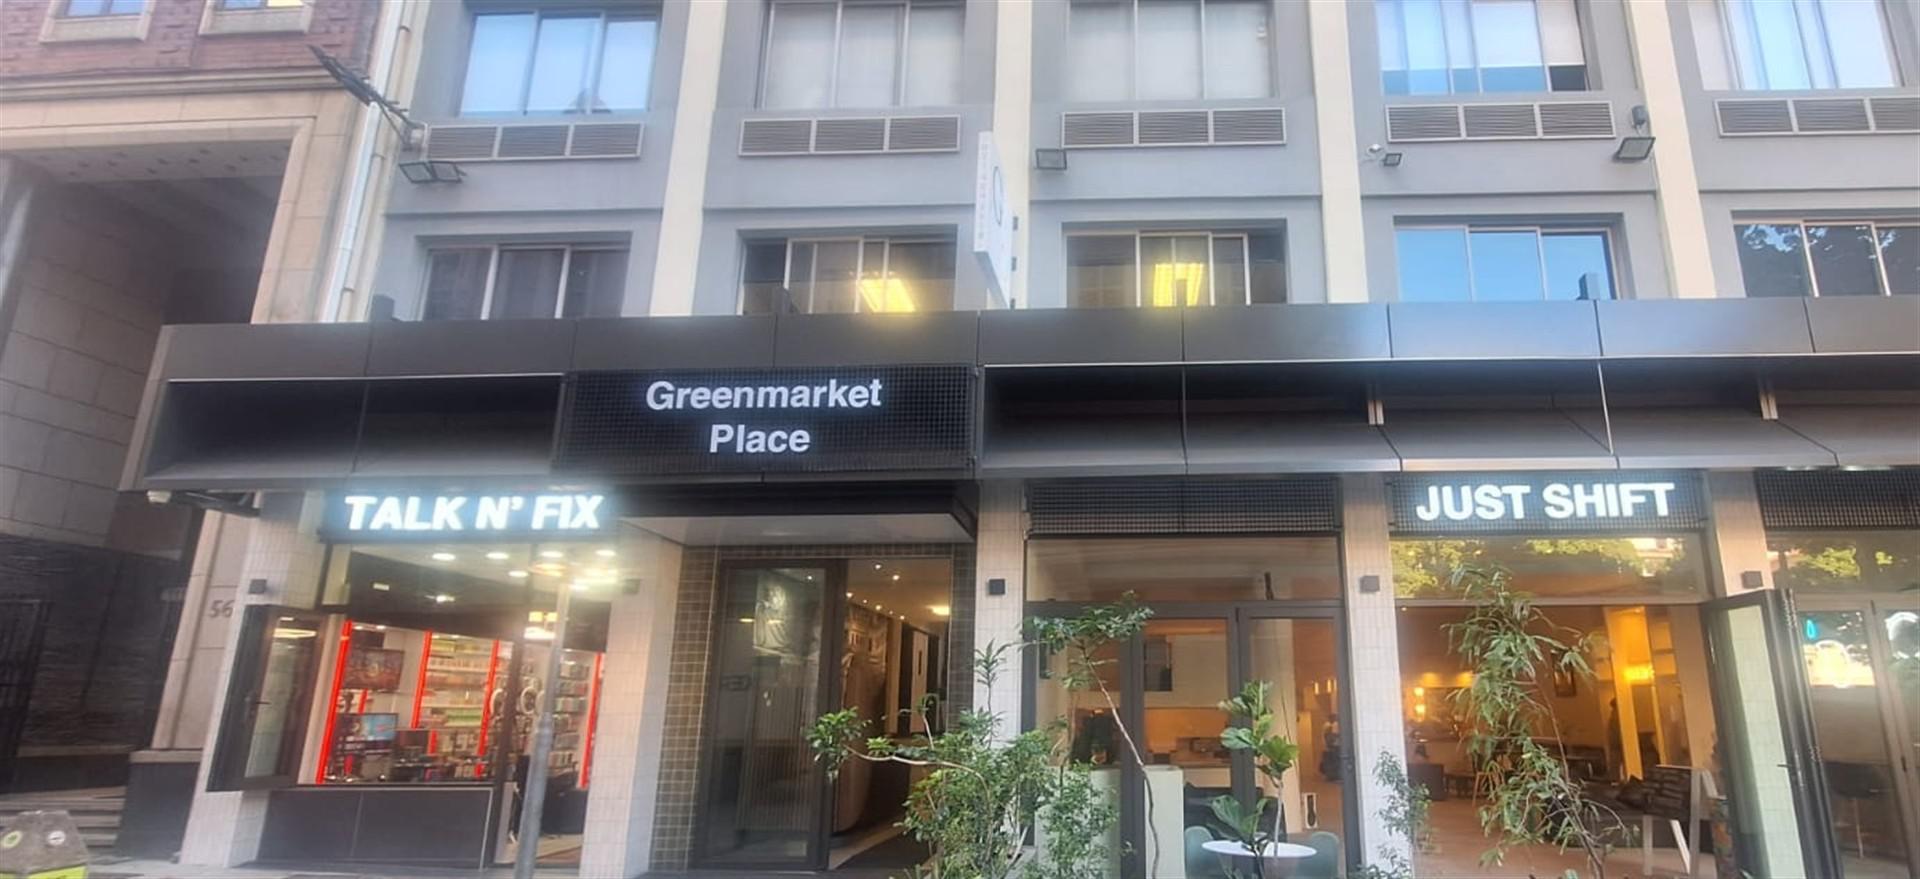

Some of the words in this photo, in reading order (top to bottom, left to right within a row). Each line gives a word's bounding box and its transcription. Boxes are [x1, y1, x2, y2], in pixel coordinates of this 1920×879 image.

[646, 379, 882, 410] Greenmarket
[709, 424, 811, 453] Place
[345, 495, 467, 530] TALK
[531, 495, 604, 529] FIX
[1416, 484, 1531, 521] JUST
[1542, 482, 1675, 519] SHIFT
[208, 599, 235, 619] 56
